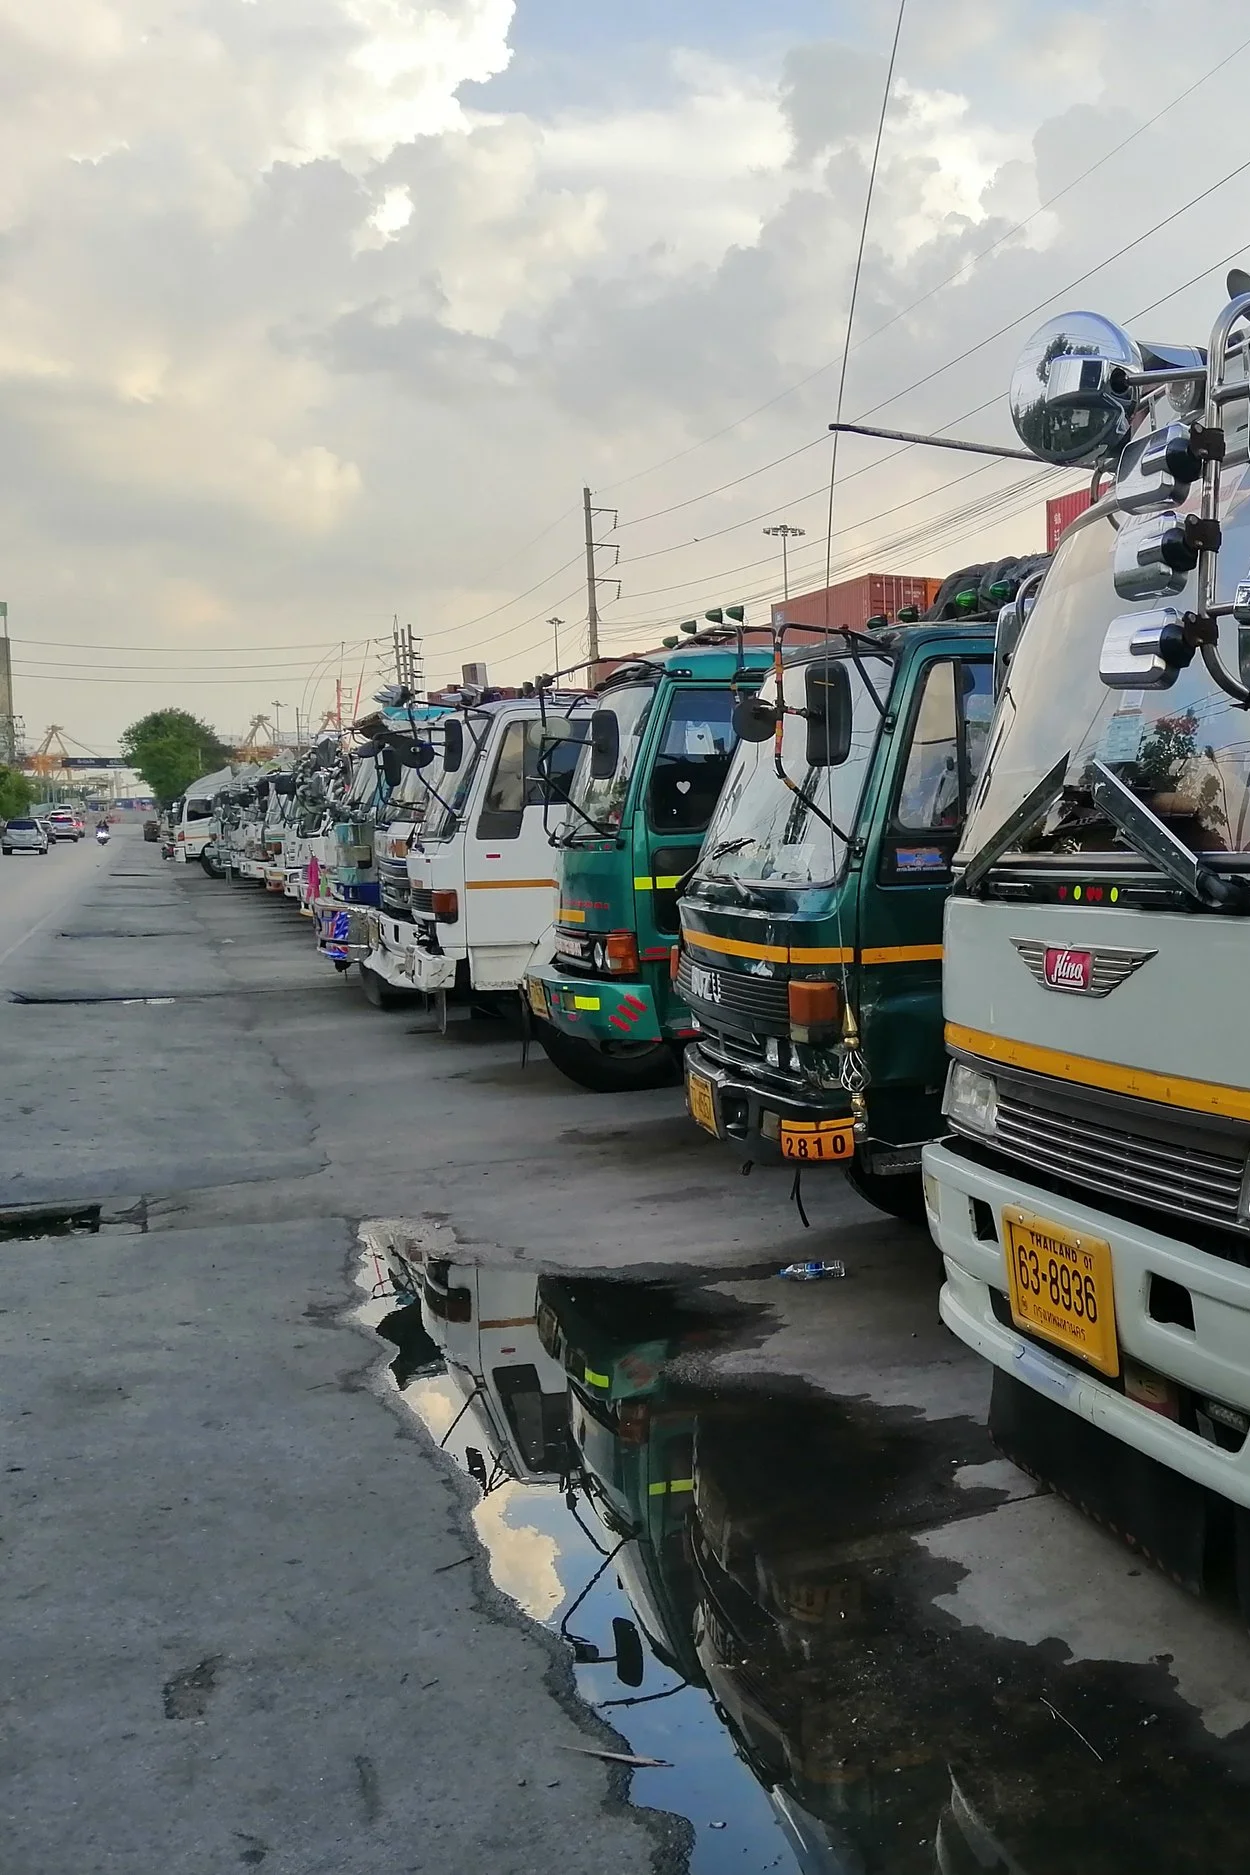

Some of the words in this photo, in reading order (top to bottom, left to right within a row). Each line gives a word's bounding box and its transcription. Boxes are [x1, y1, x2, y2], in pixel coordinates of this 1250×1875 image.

[1051, 951, 1084, 986] Hino
[786, 1134, 847, 1158] 2810
[1029, 1232, 1078, 1263] THAILAND
[1083, 1256, 1093, 1270] 01
[1018, 1245, 1098, 1323] 63-8936
